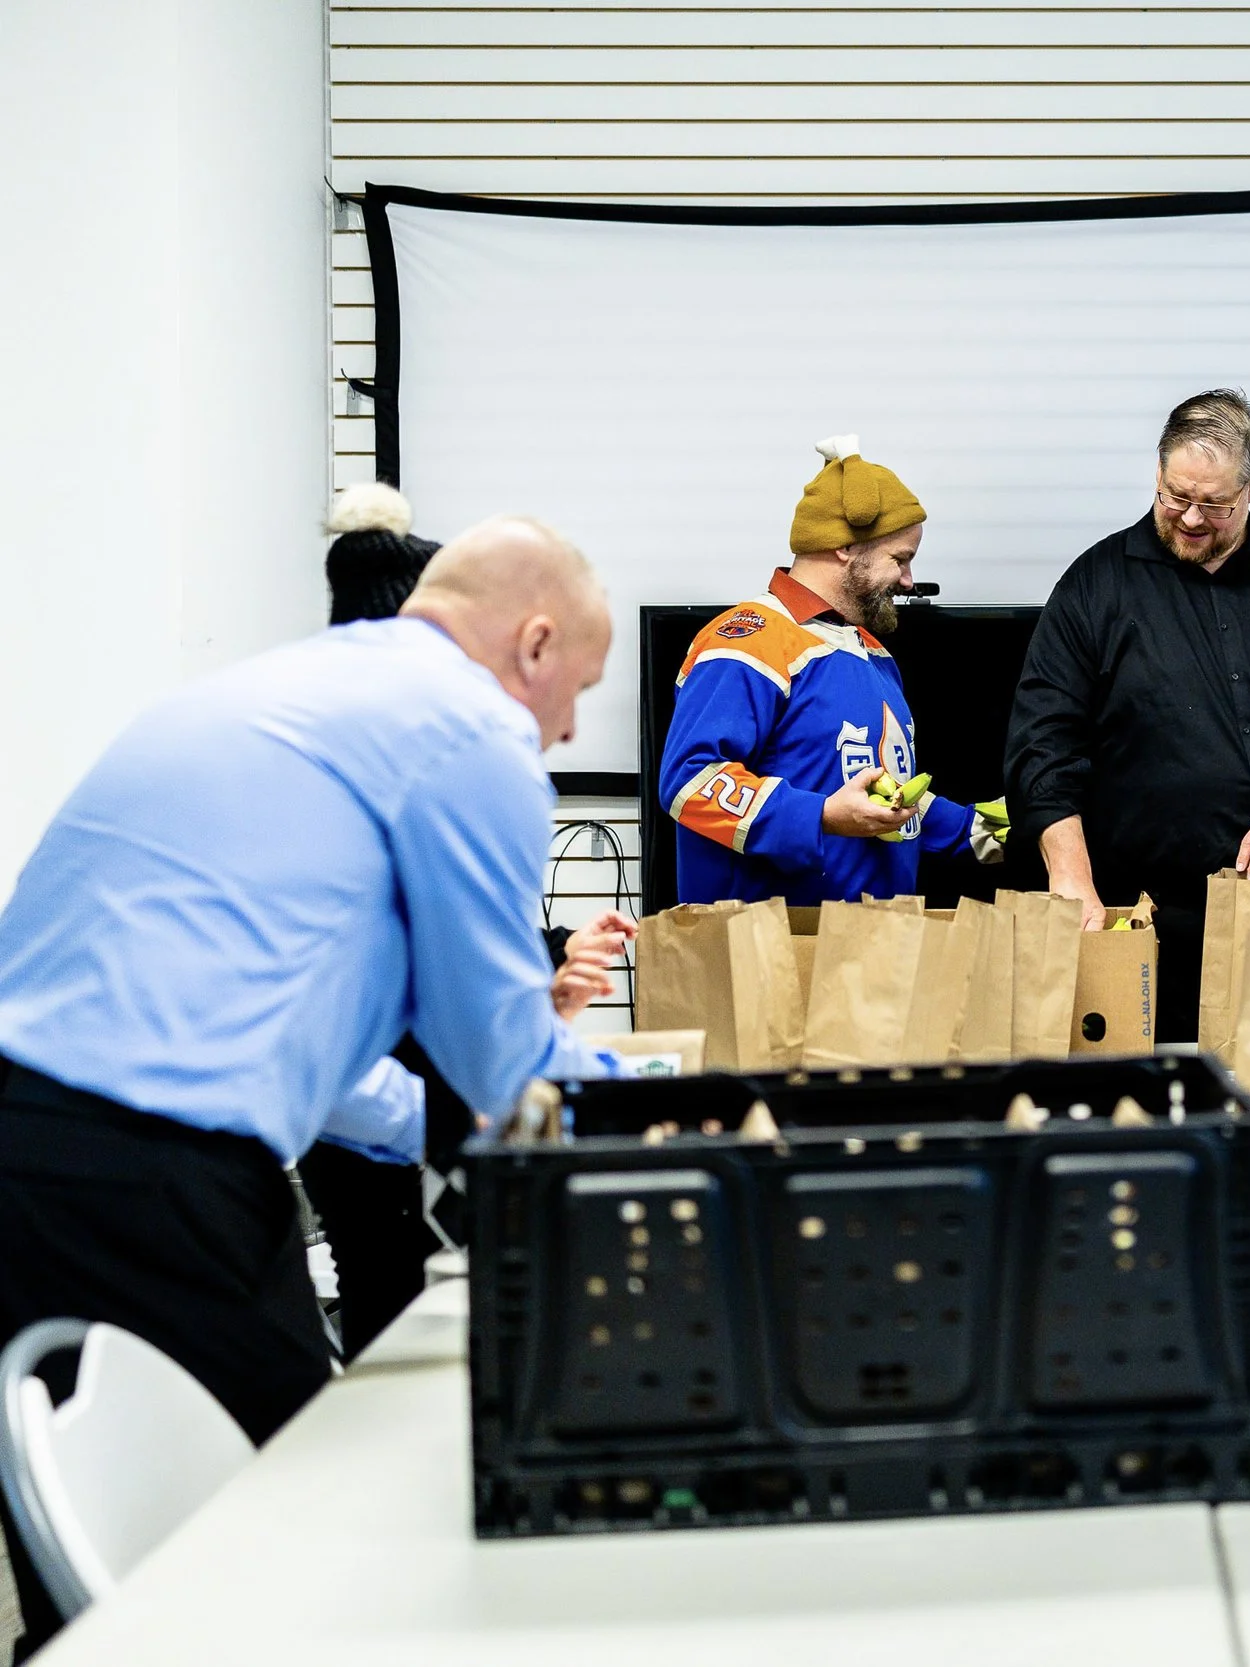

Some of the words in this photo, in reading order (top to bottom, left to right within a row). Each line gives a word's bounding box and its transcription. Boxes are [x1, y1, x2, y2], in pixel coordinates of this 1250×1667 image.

[893, 744, 907, 774] 2
[699, 772, 756, 818] 2
[1141, 963, 1150, 977] BX
